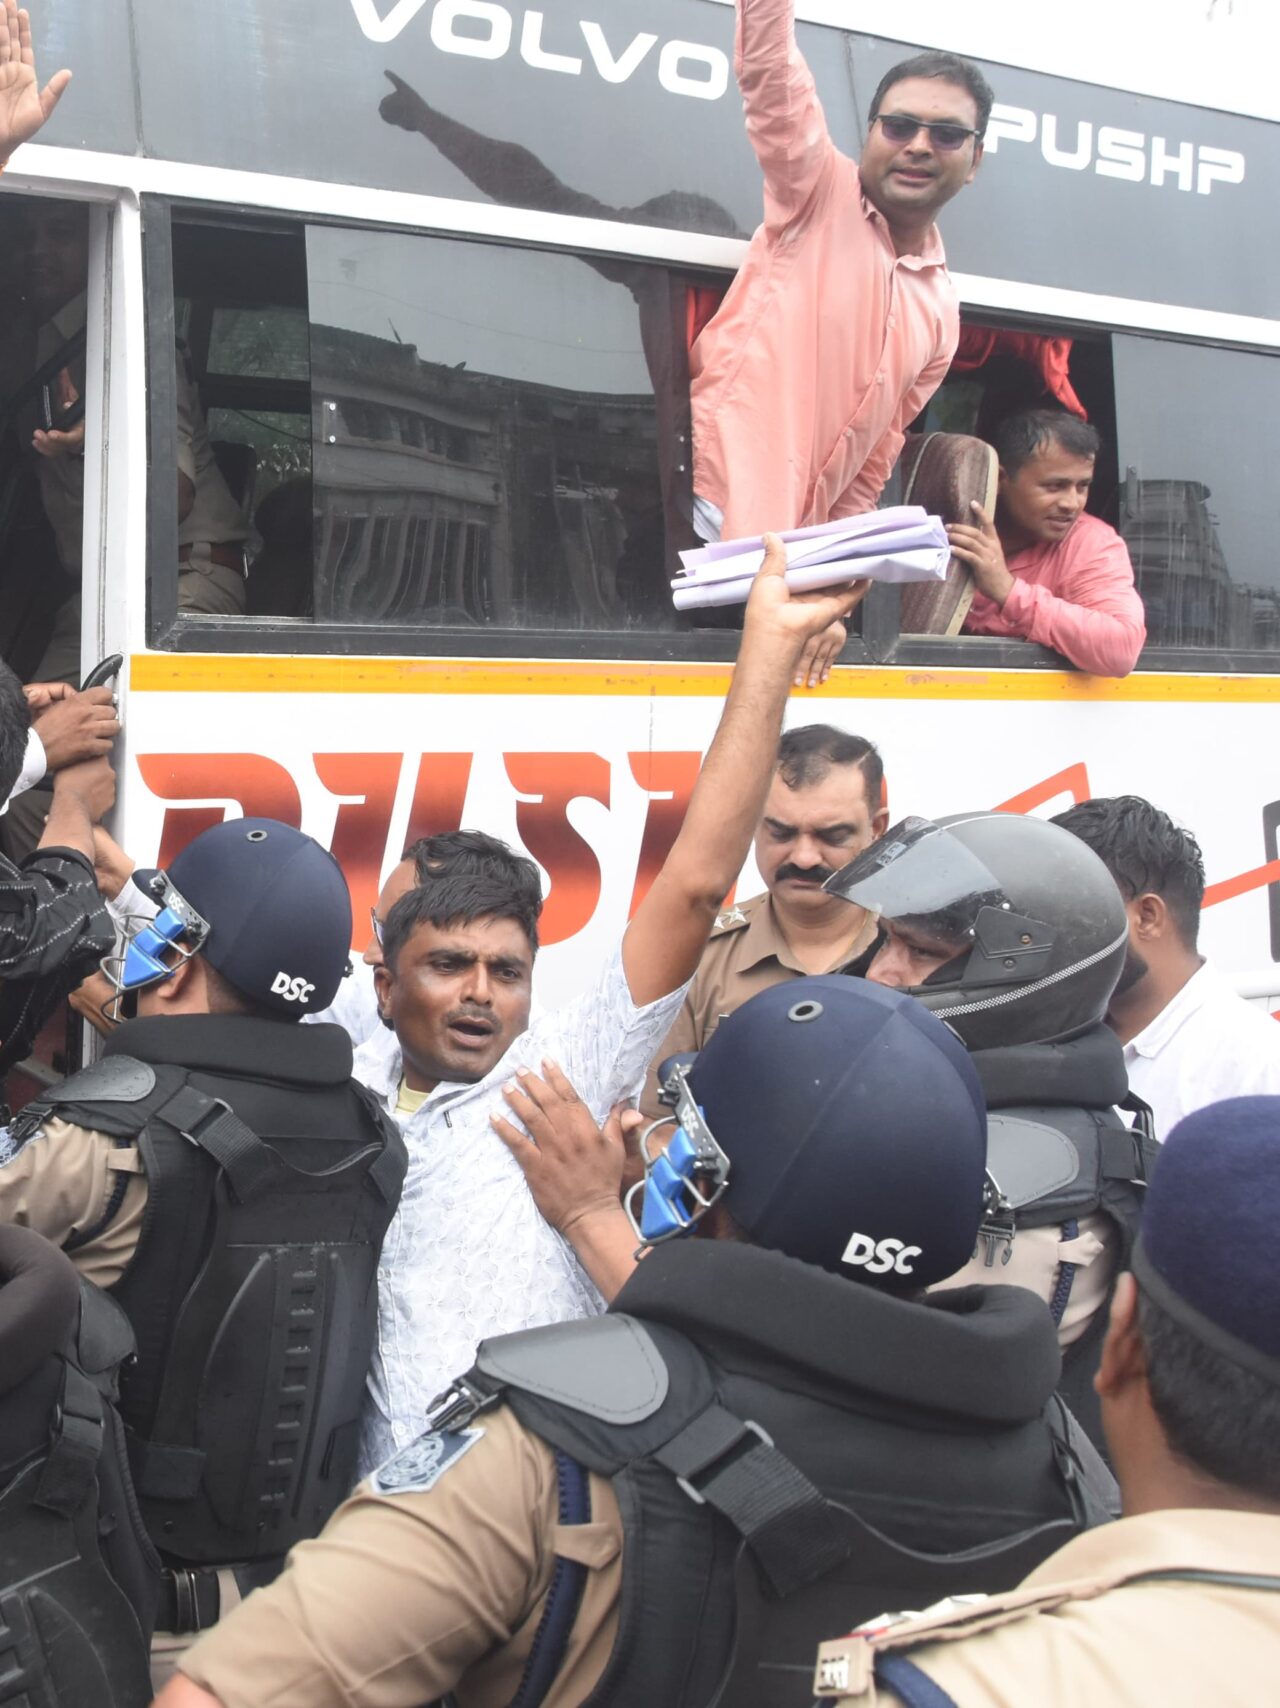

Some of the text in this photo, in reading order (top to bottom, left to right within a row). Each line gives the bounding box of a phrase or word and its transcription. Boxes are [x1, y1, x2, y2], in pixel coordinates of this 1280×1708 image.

[350, 0, 729, 101] VOLVO
[983, 102, 1246, 196] PUSHP
[270, 971, 316, 1004] DSC
[840, 1231, 923, 1275] DSC
